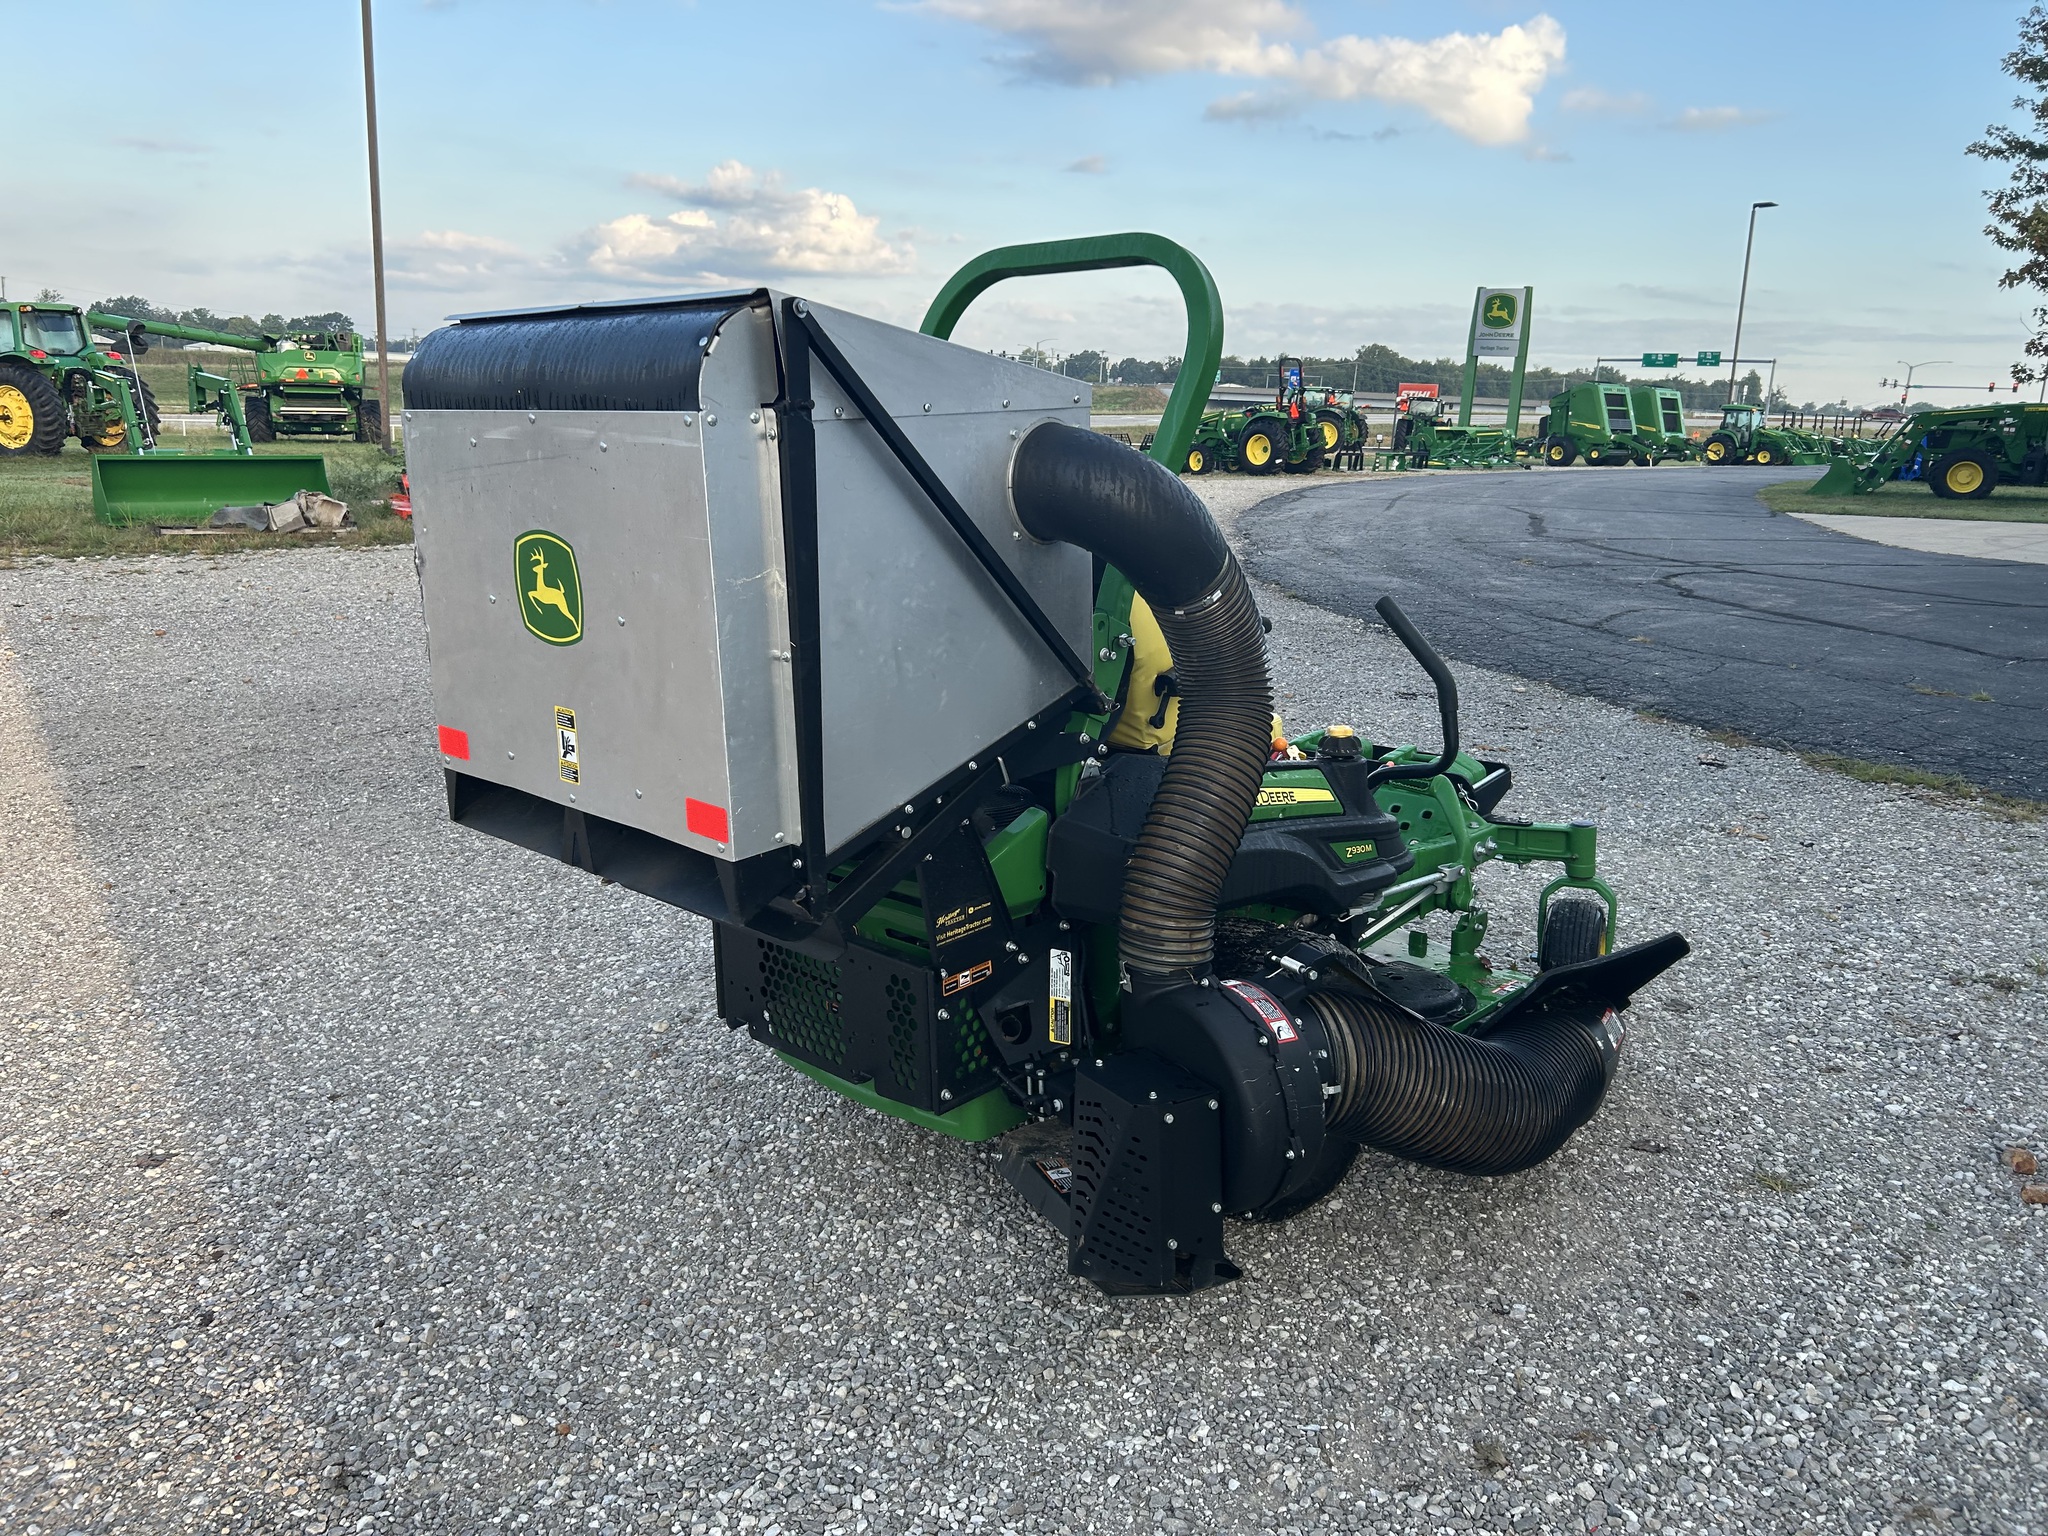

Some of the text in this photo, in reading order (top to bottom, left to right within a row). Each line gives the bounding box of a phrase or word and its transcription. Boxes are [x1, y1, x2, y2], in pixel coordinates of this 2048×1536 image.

[1260, 790, 1297, 804] DEERE
[1346, 844, 1373, 858] Z930M
[946, 916, 992, 938] HeritageTractor.com
